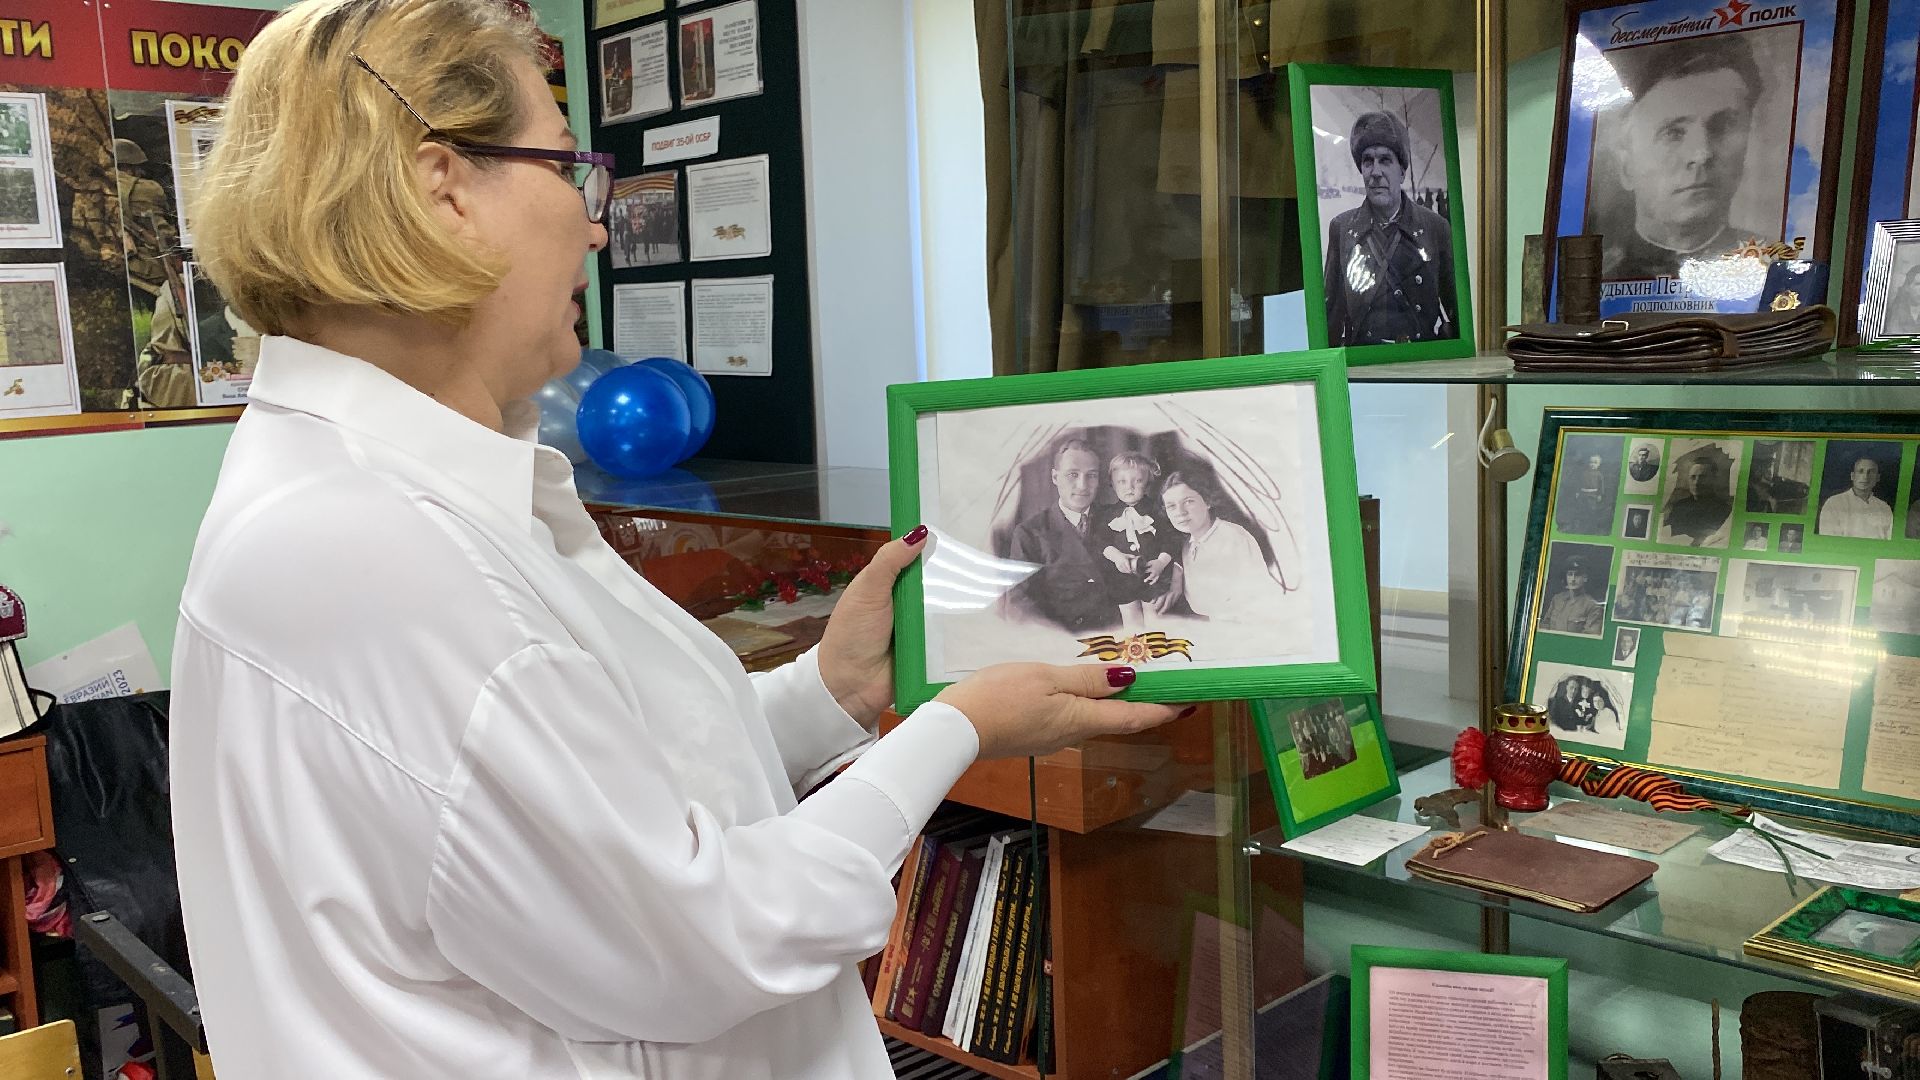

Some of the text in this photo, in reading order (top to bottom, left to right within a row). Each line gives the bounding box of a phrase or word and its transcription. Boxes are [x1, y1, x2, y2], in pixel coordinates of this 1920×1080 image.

[0, 18, 247, 70] ТИ ПОКО
[651, 138, 675, 151] ПОДВИГ
[1632, 299, 1715, 313] подполковник
[112, 669, 131, 696] 2023
